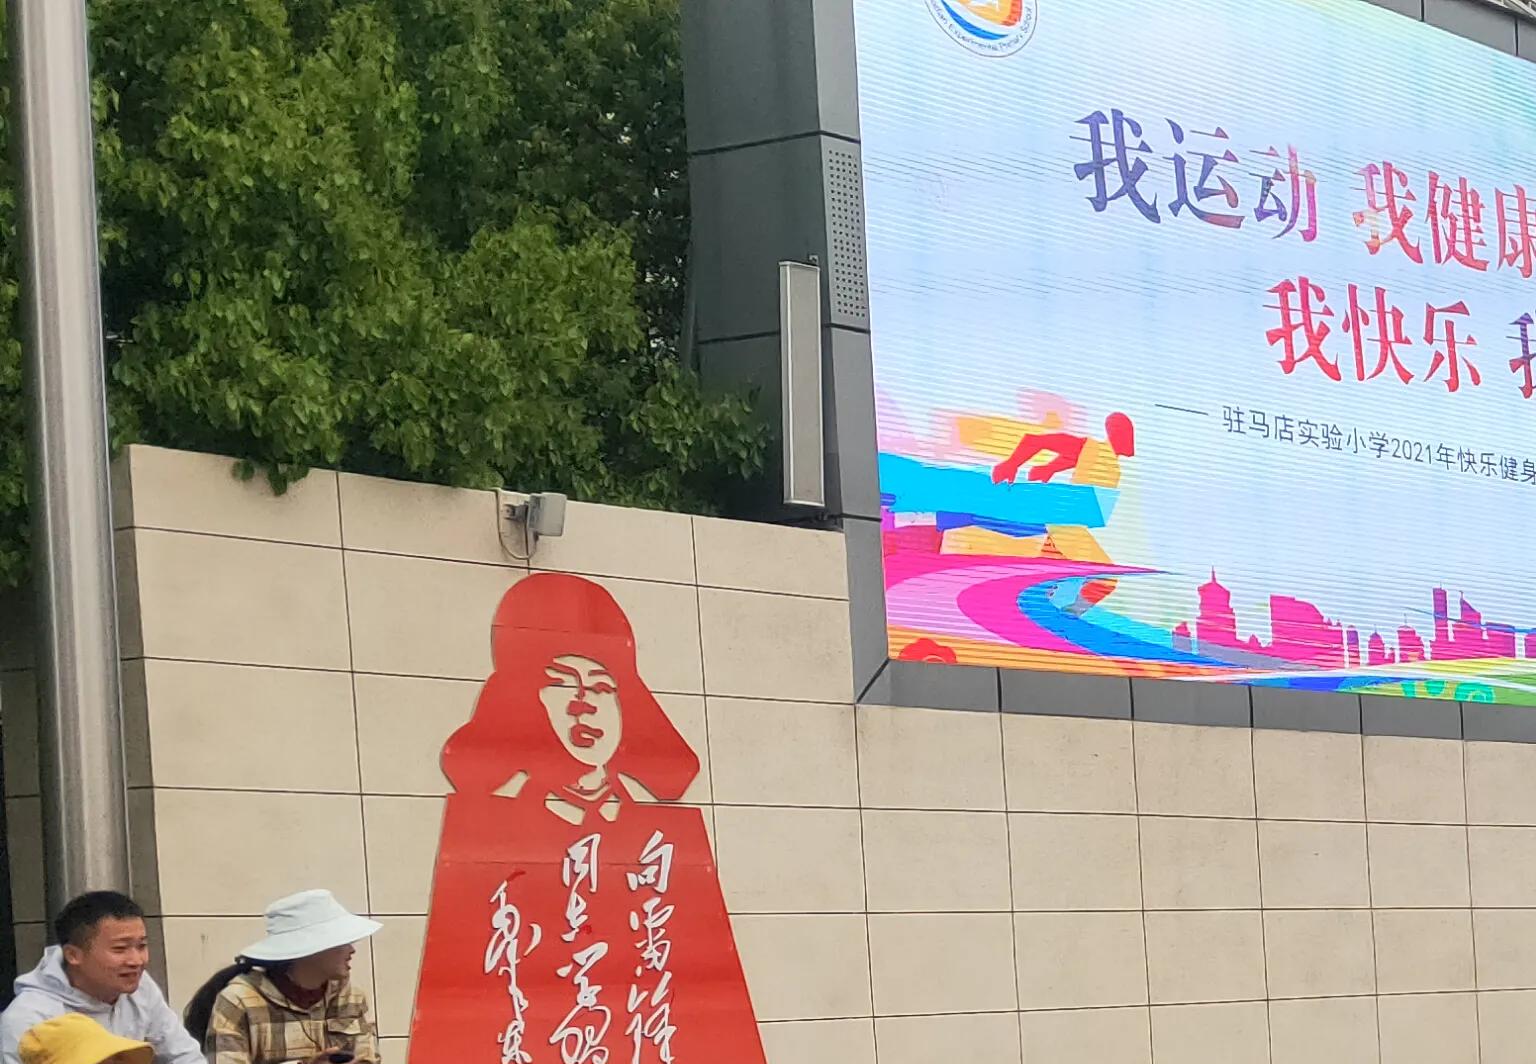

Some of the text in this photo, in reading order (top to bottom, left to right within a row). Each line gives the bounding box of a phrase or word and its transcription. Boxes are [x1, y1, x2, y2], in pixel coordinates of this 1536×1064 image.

[1068, 108, 1317, 242] 我运动
[1262, 276, 1482, 393] 我快乐
